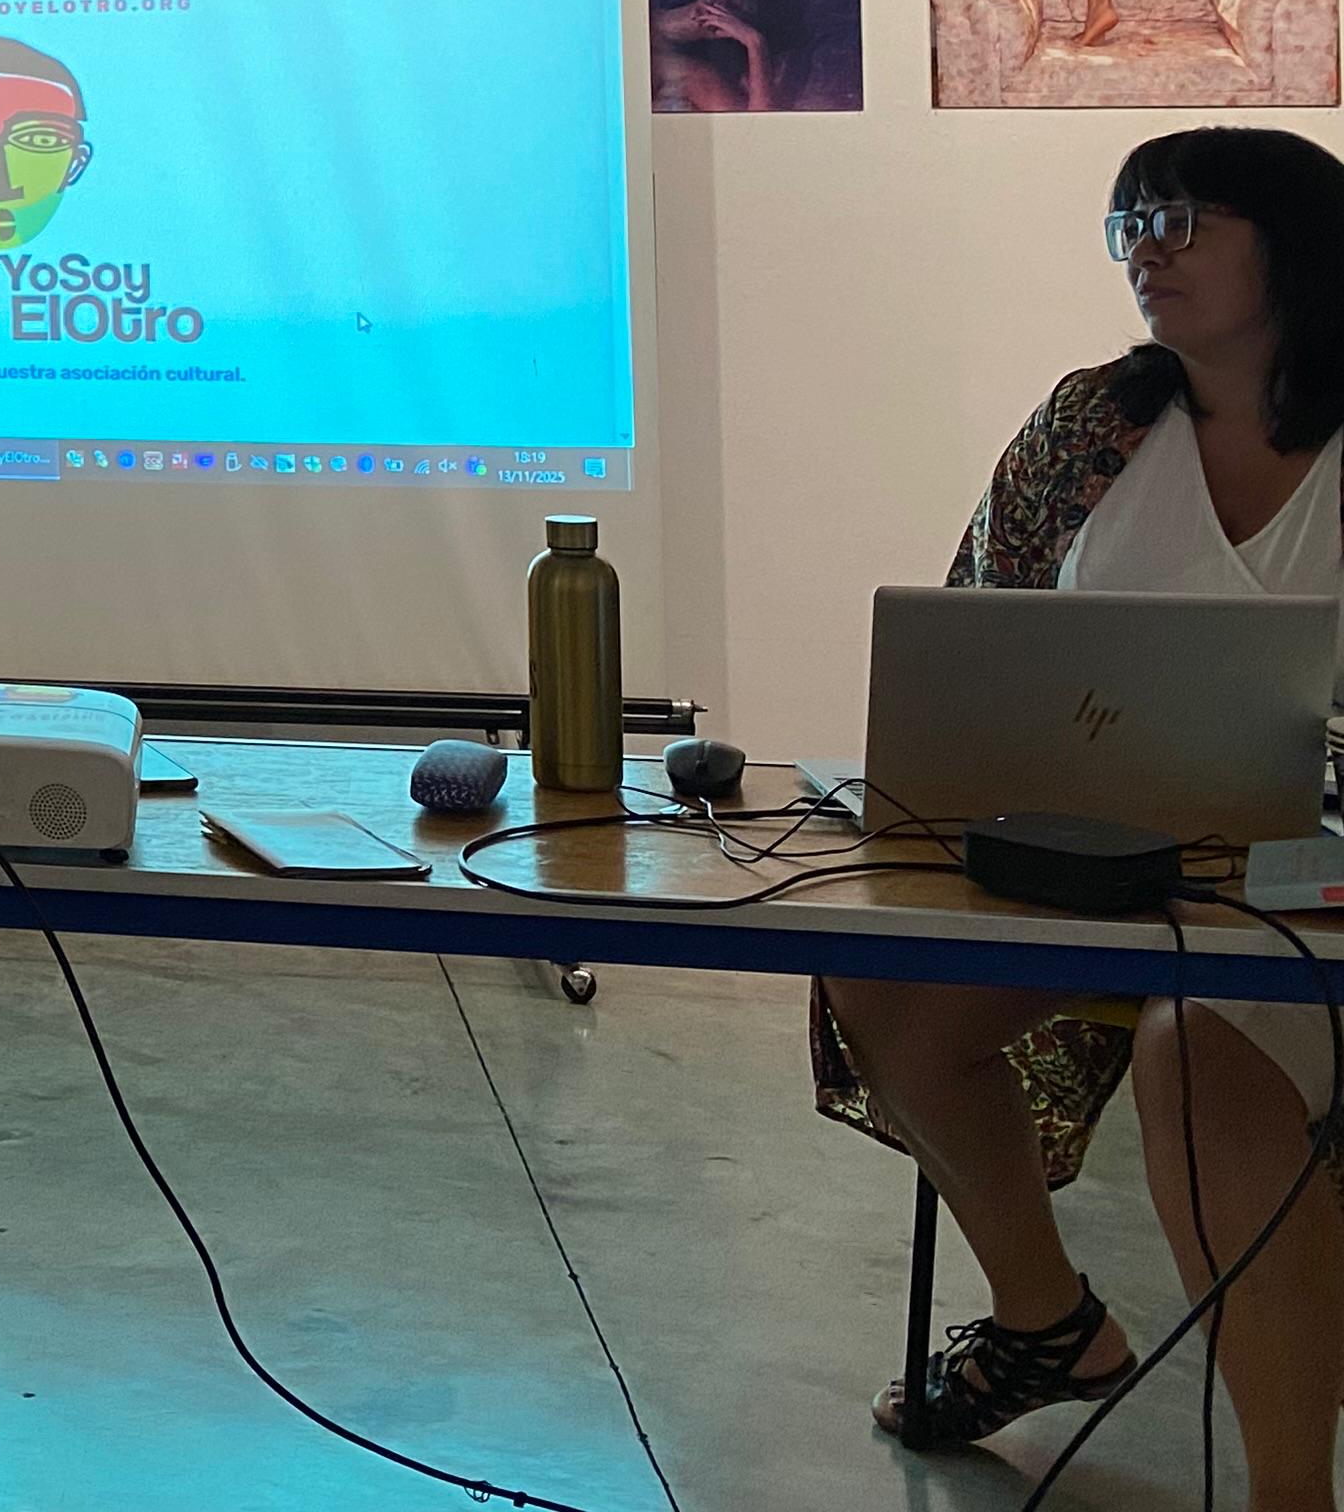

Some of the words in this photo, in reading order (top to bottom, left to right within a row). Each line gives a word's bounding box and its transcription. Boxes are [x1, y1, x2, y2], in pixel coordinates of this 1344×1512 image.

[1, 253, 151, 304] YoSoy
[11, 294, 205, 343] ElOtro
[60, 365, 161, 381] asociación
[165, 366, 247, 382] cultural.
[514, 451, 546, 464] 18:19
[498, 470, 566, 483] 13/11/2025
[1073, 688, 1121, 742] hp
